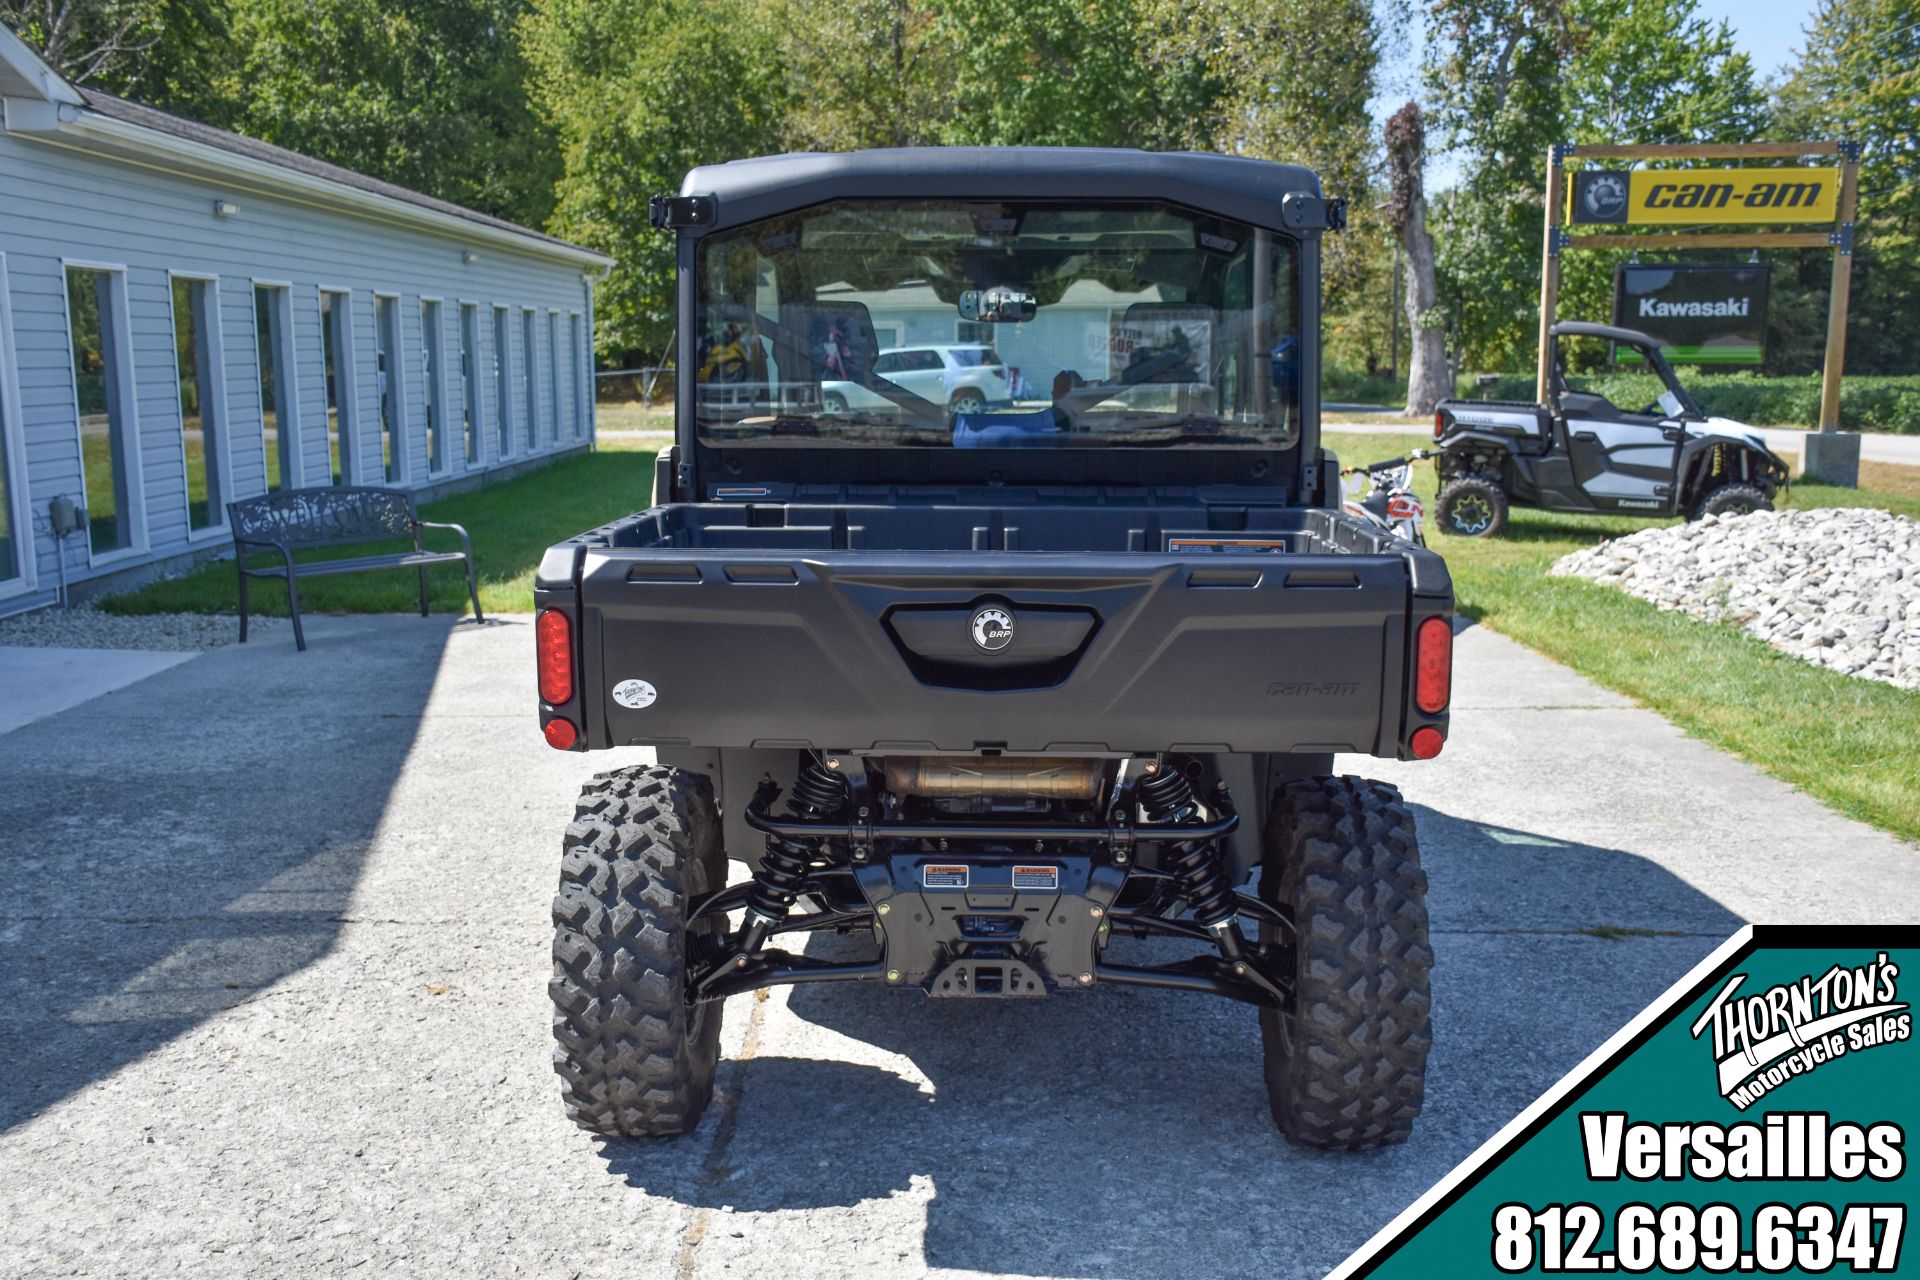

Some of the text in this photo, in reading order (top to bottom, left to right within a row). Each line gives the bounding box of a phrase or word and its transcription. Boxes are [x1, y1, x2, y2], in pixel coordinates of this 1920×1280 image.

[1644, 182, 1822, 208] can-am
[1639, 297, 1749, 317] Kawasaki
[1618, 499, 1659, 509] Kawasaki
[989, 630, 1011, 638] BRP
